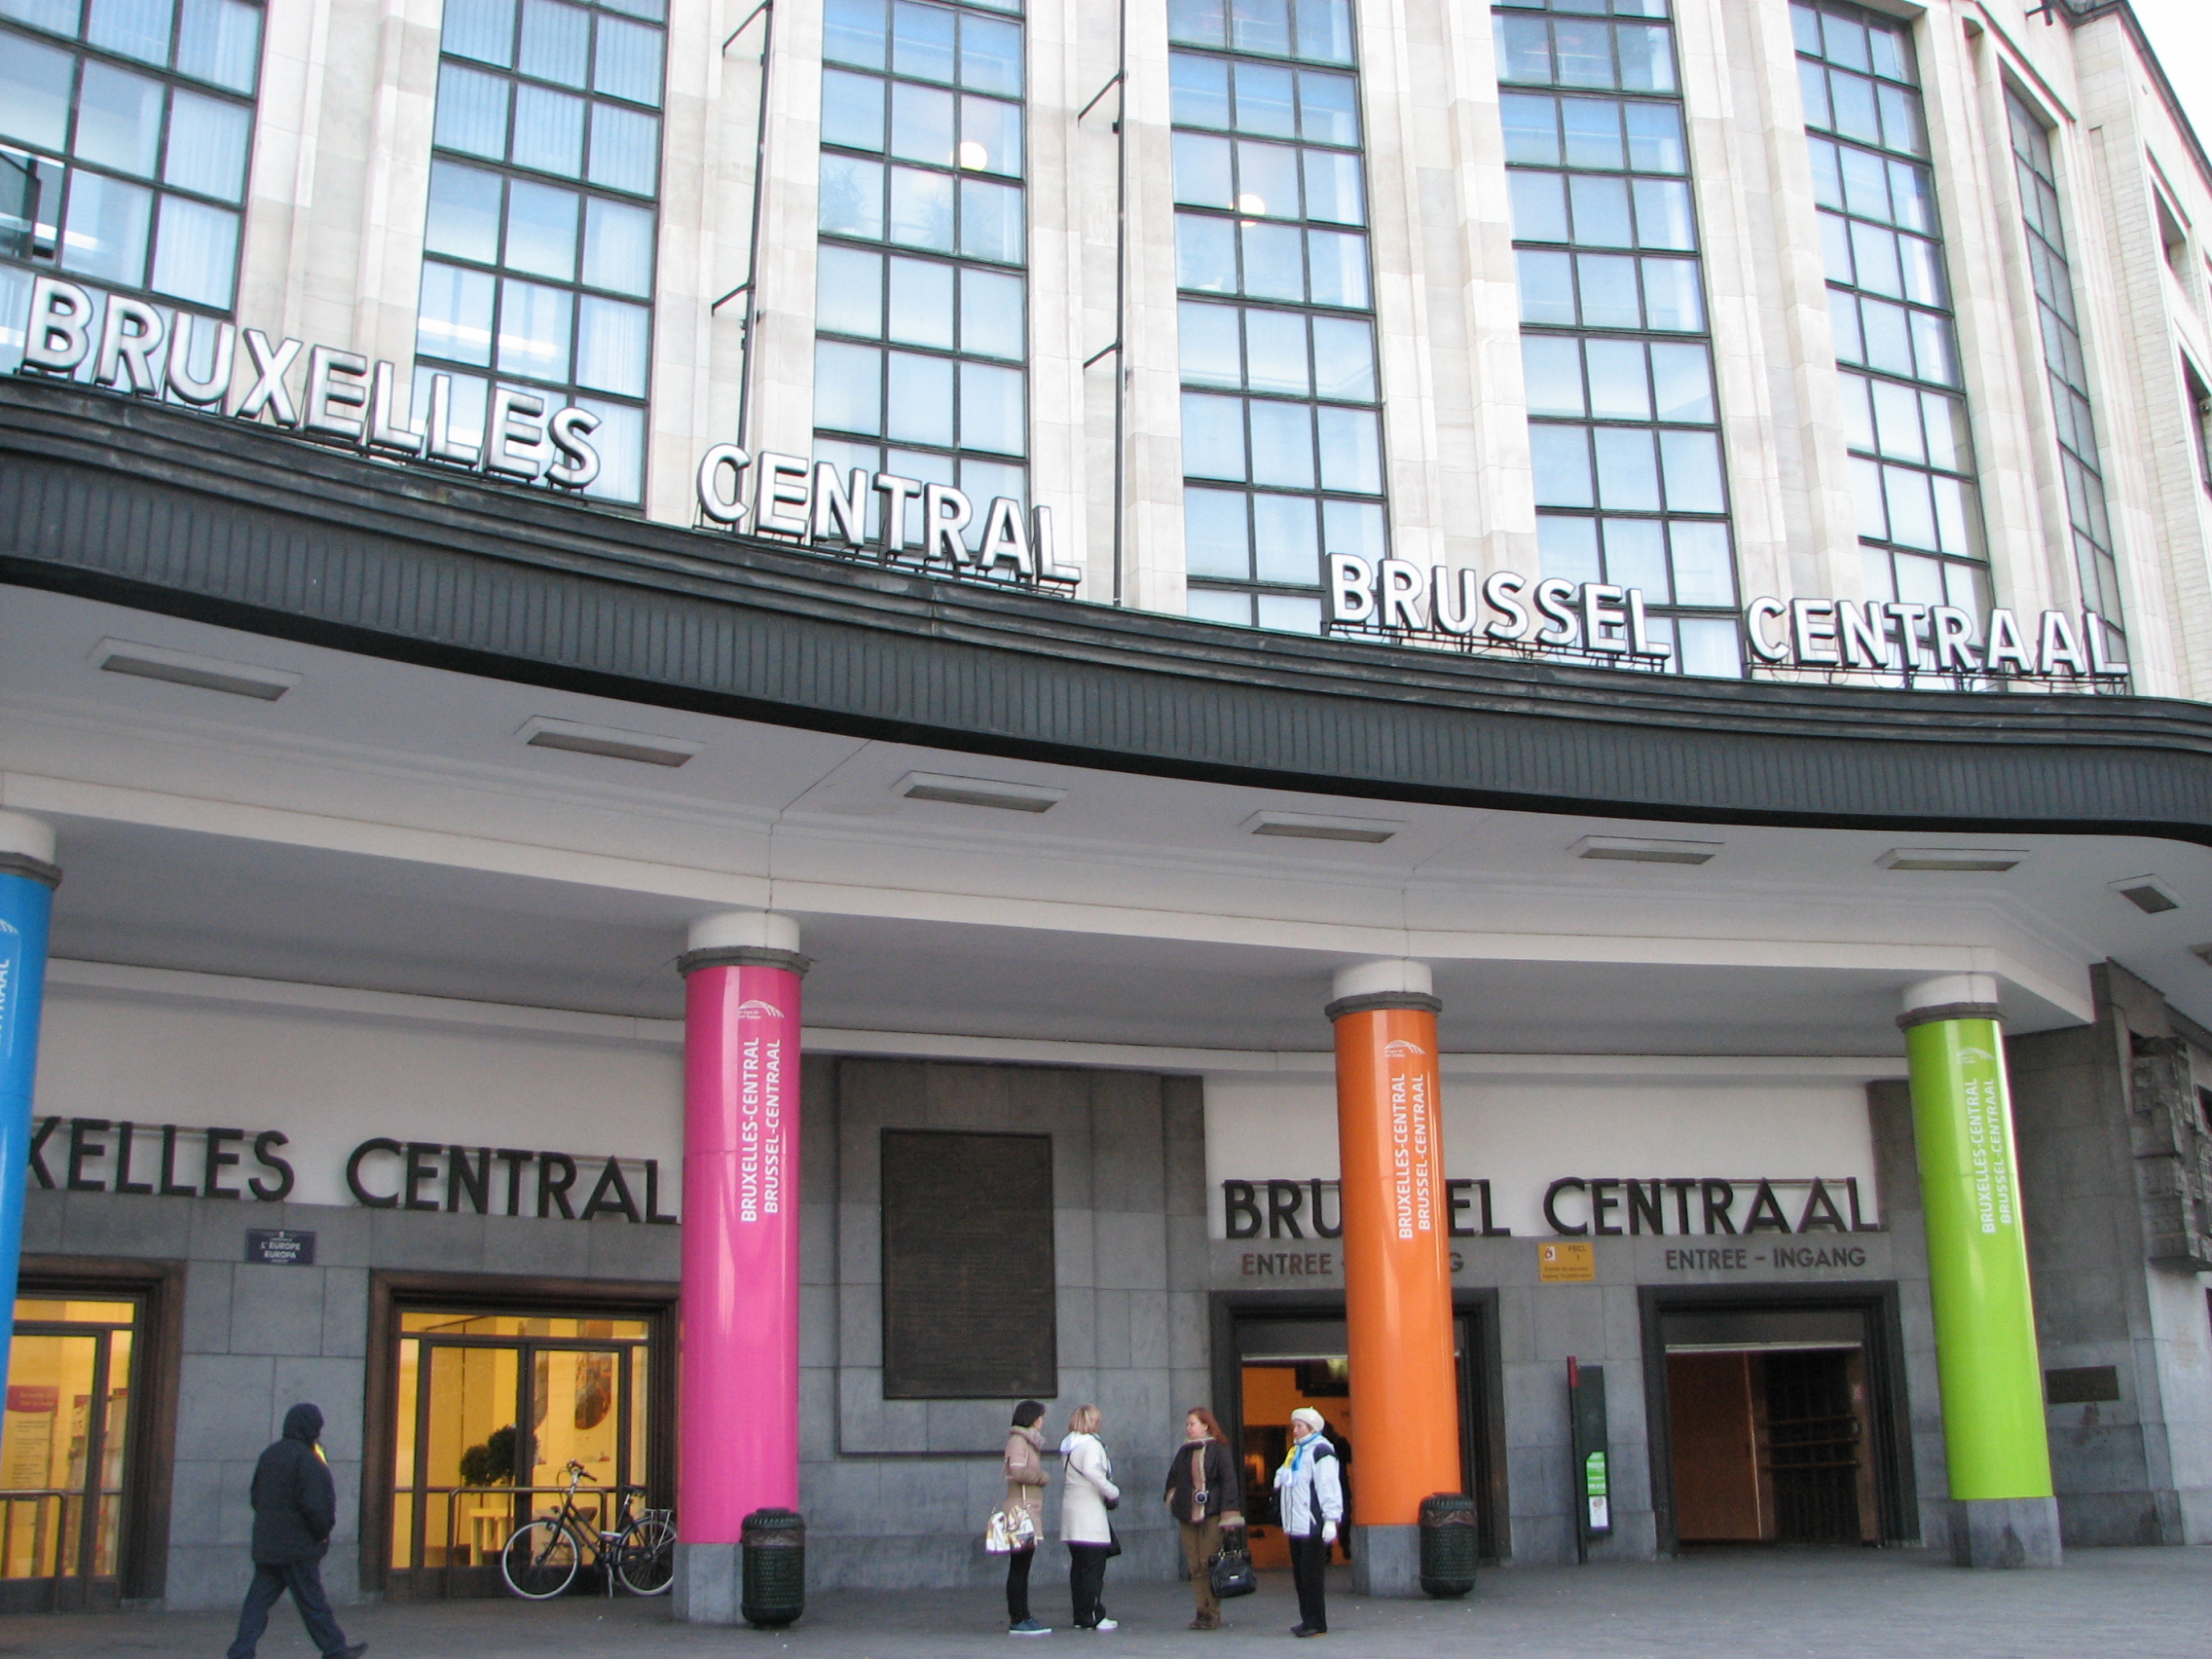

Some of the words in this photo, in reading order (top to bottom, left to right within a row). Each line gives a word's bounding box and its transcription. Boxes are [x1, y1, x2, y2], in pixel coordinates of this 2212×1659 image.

[22, 276, 603, 489] BRUXELLES
[696, 442, 1082, 585] CENTRAL
[1327, 552, 1670, 656] BRUSSEL
[1749, 595, 2129, 676] CENTRAAL
[346, 1137, 678, 1225] CENTRAL
[741, 1037, 760, 1223] BRUXELLES-CENTRAL
[763, 1039, 781, 1214] BRUSSEL-CENTRAAL
[1391, 1073, 1413, 1239] BRUXELLES-CENTRAL
[1412, 1074, 1431, 1231] BRUSSEL-CENTRAAL
[1965, 1077, 1997, 1234] BRUXELLES-CENTRAL
[1984, 1078, 2012, 1225] BRUSSEL-CENTRAAL
[264, 1250, 297, 1259] EUROPA
[268, 1241, 301, 1250] EUROPE
[1223, 1178, 1511, 1239] BRUEL
[1542, 1176, 1879, 1236] CENTRAAL
[1241, 1252, 1333, 1275] ENTREE
[1665, 1248, 1748, 1270] ENTREE
[1773, 1247, 1867, 1269] INGANG
